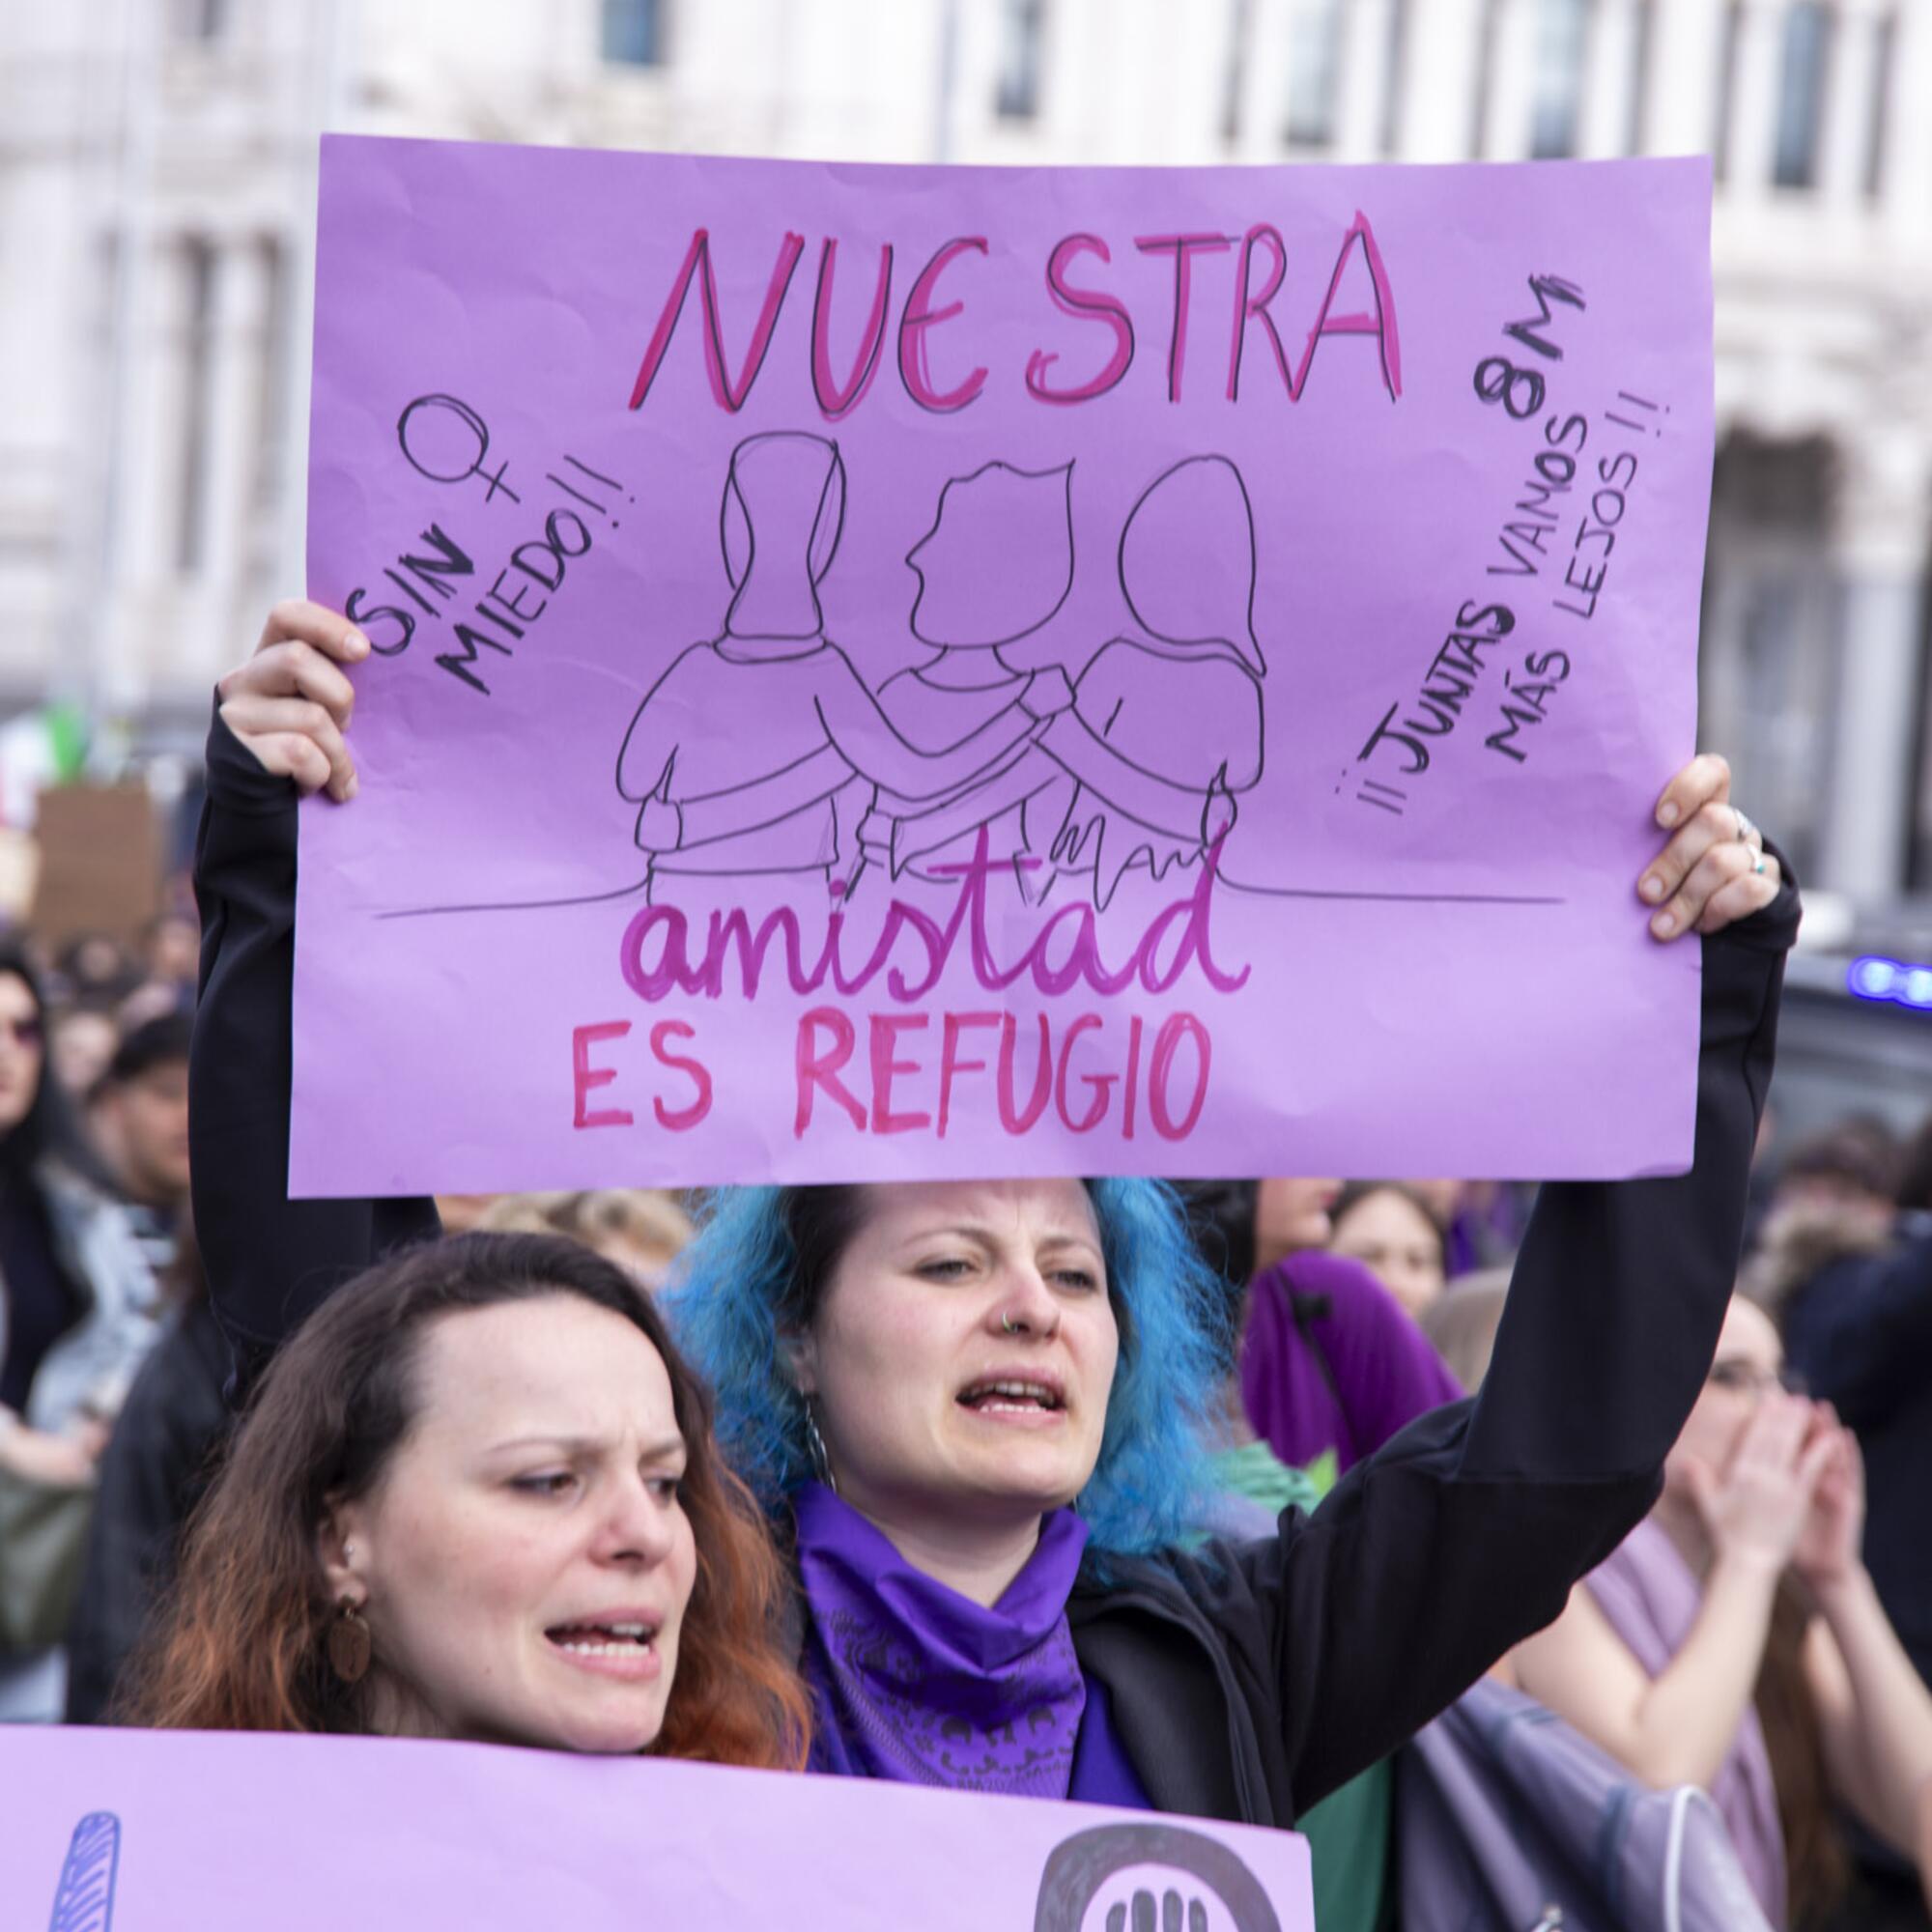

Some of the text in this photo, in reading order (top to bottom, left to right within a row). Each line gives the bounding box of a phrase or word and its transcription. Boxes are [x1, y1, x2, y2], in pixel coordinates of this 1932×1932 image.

[629, 208, 1403, 423] NUESTRA
[1474, 272, 1586, 421] 8M
[1486, 412, 1588, 577] VAMOS
[345, 522, 475, 657] SIN
[434, 454, 636, 696] MIEDO!!
[1485, 648, 1571, 763] MÁS
[619, 818, 1253, 1003] amistad
[572, 1006, 1212, 1141] ES REFUGIO
